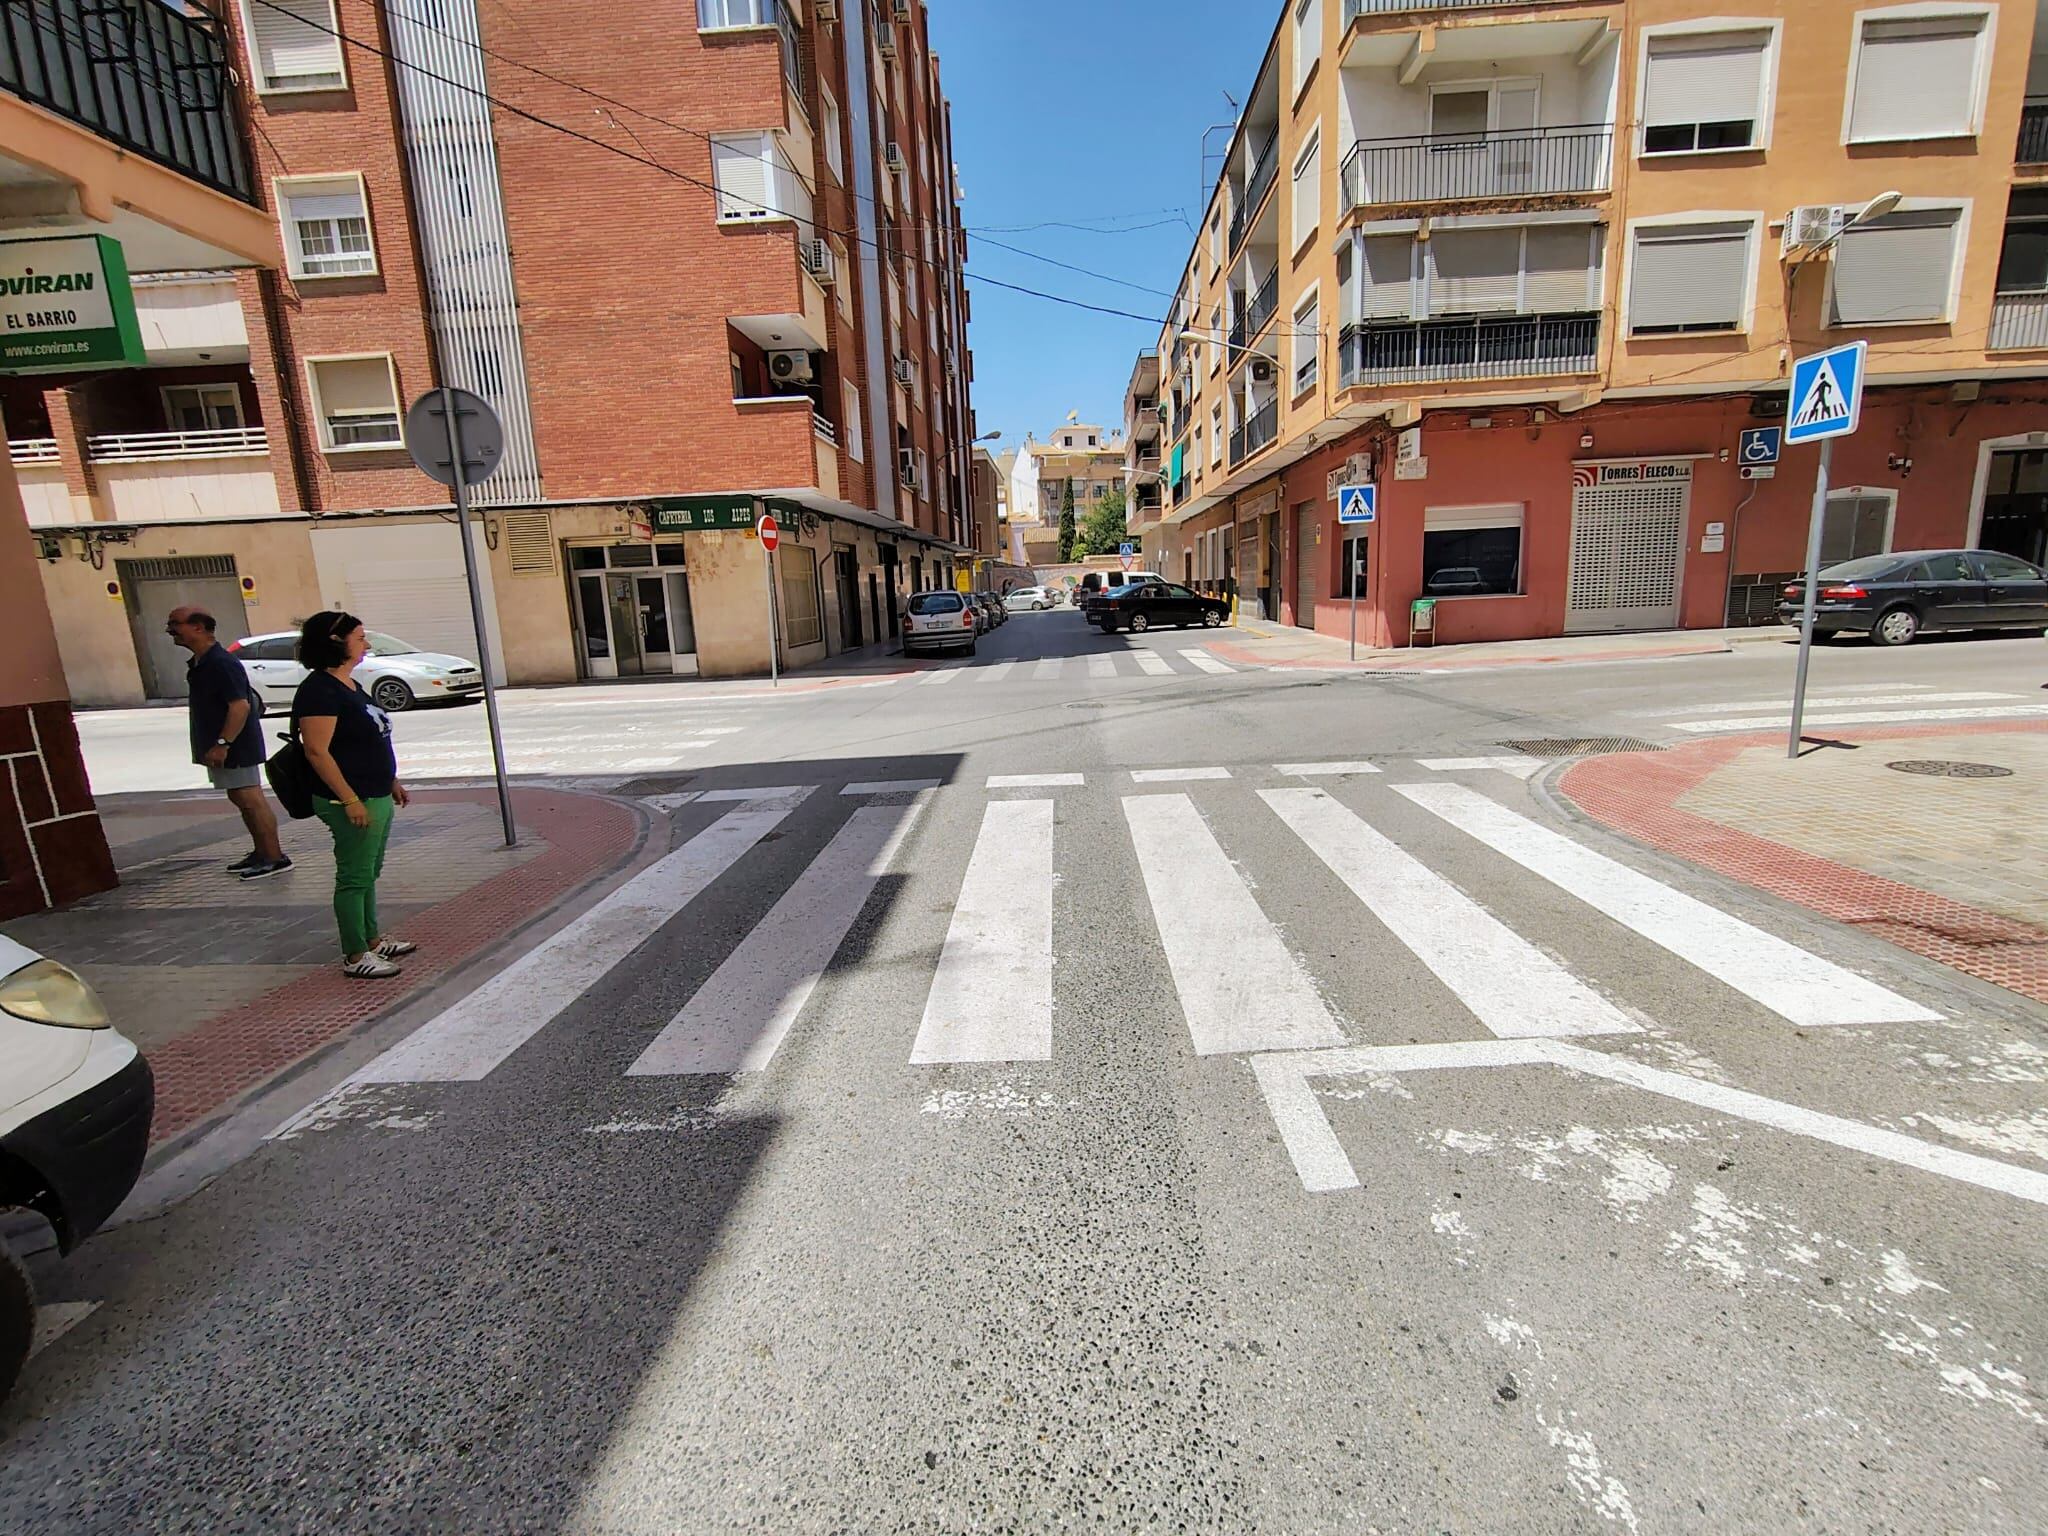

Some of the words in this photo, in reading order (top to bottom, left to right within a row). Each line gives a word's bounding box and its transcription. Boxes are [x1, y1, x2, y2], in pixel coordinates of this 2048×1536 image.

[6, 314, 24, 329] EL
[27, 310, 77, 327] BARRIO
[4, 341, 90, 357] www.coviran.es
[658, 510, 692, 525] CAFETERIA
[703, 509, 715, 523] LOS
[732, 508, 751, 522] ALPES
